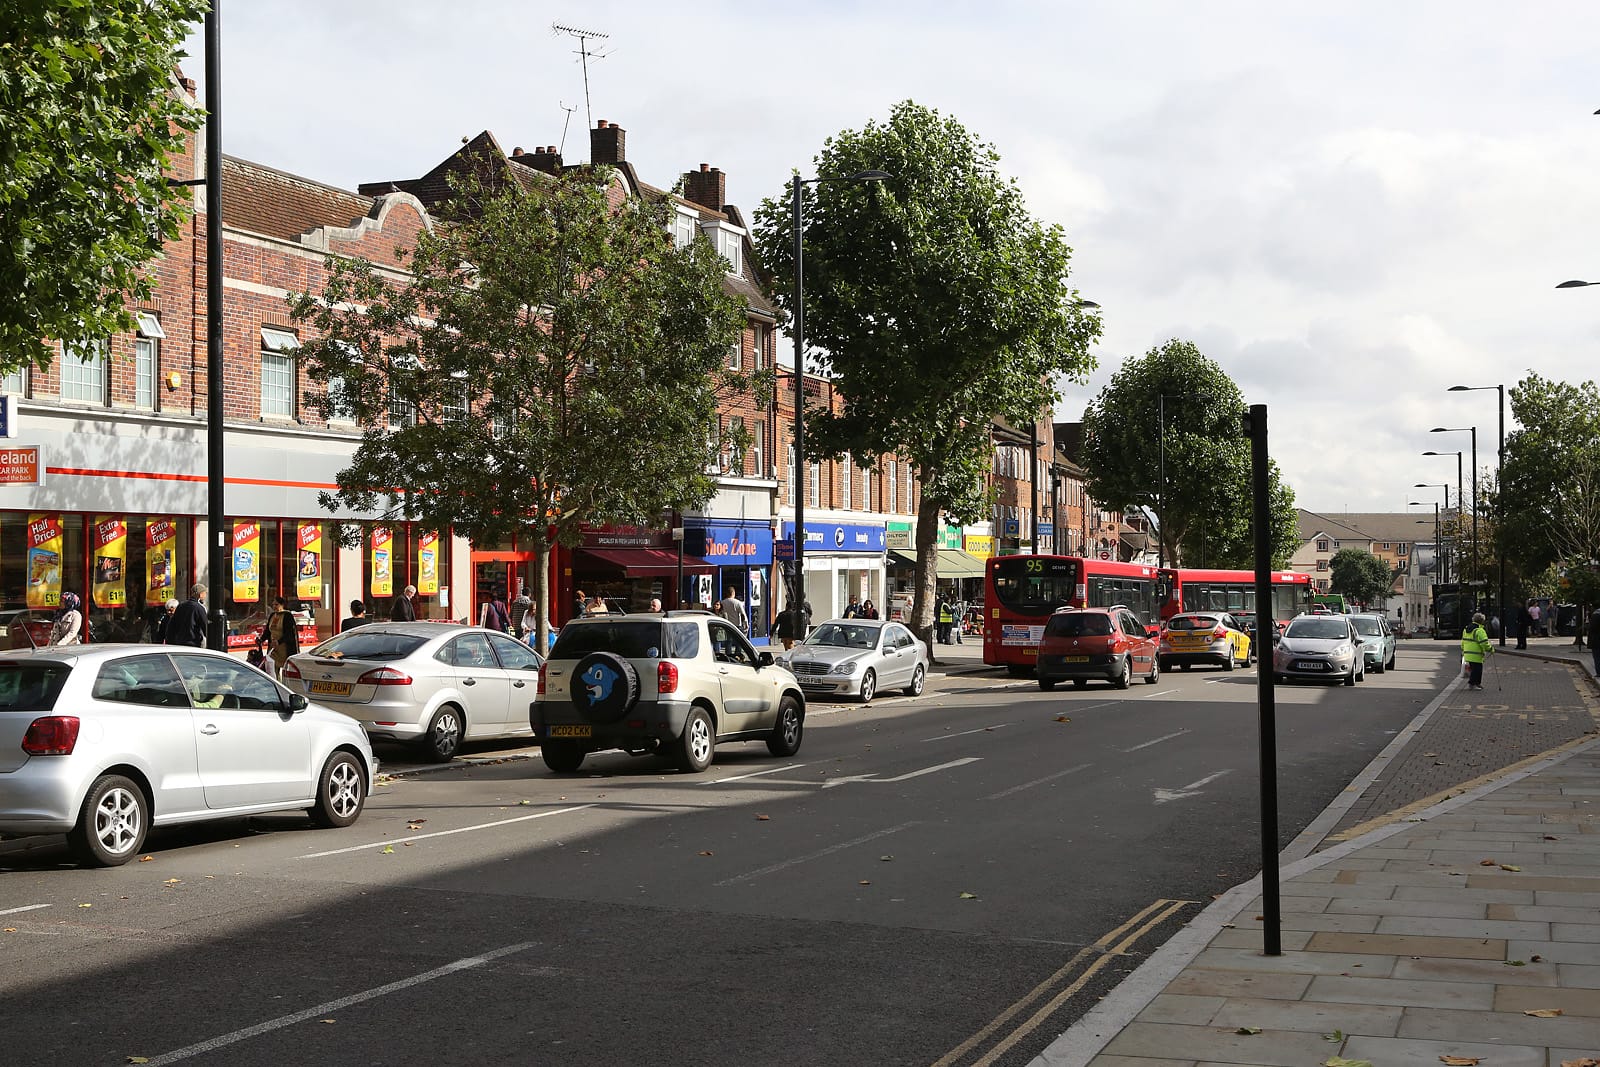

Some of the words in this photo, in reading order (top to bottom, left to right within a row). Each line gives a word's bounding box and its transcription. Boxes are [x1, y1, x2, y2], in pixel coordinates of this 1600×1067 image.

[0, 450, 36, 465] eland
[11, 466, 29, 474] PARK
[31, 518, 48, 535] Half
[99, 520, 119, 534] Extra
[150, 521, 169, 535] Extra
[234, 524, 255, 542] WOW!
[300, 525, 316, 537] Extra
[33, 528, 55, 545] Price
[101, 530, 118, 544] Free
[152, 531, 168, 545] Free
[302, 533, 315, 545] Free
[375, 534, 388, 545] Free
[422, 535, 433, 546] Free
[730, 538, 757, 556] Zone
[1026, 559, 1043, 572] 95
